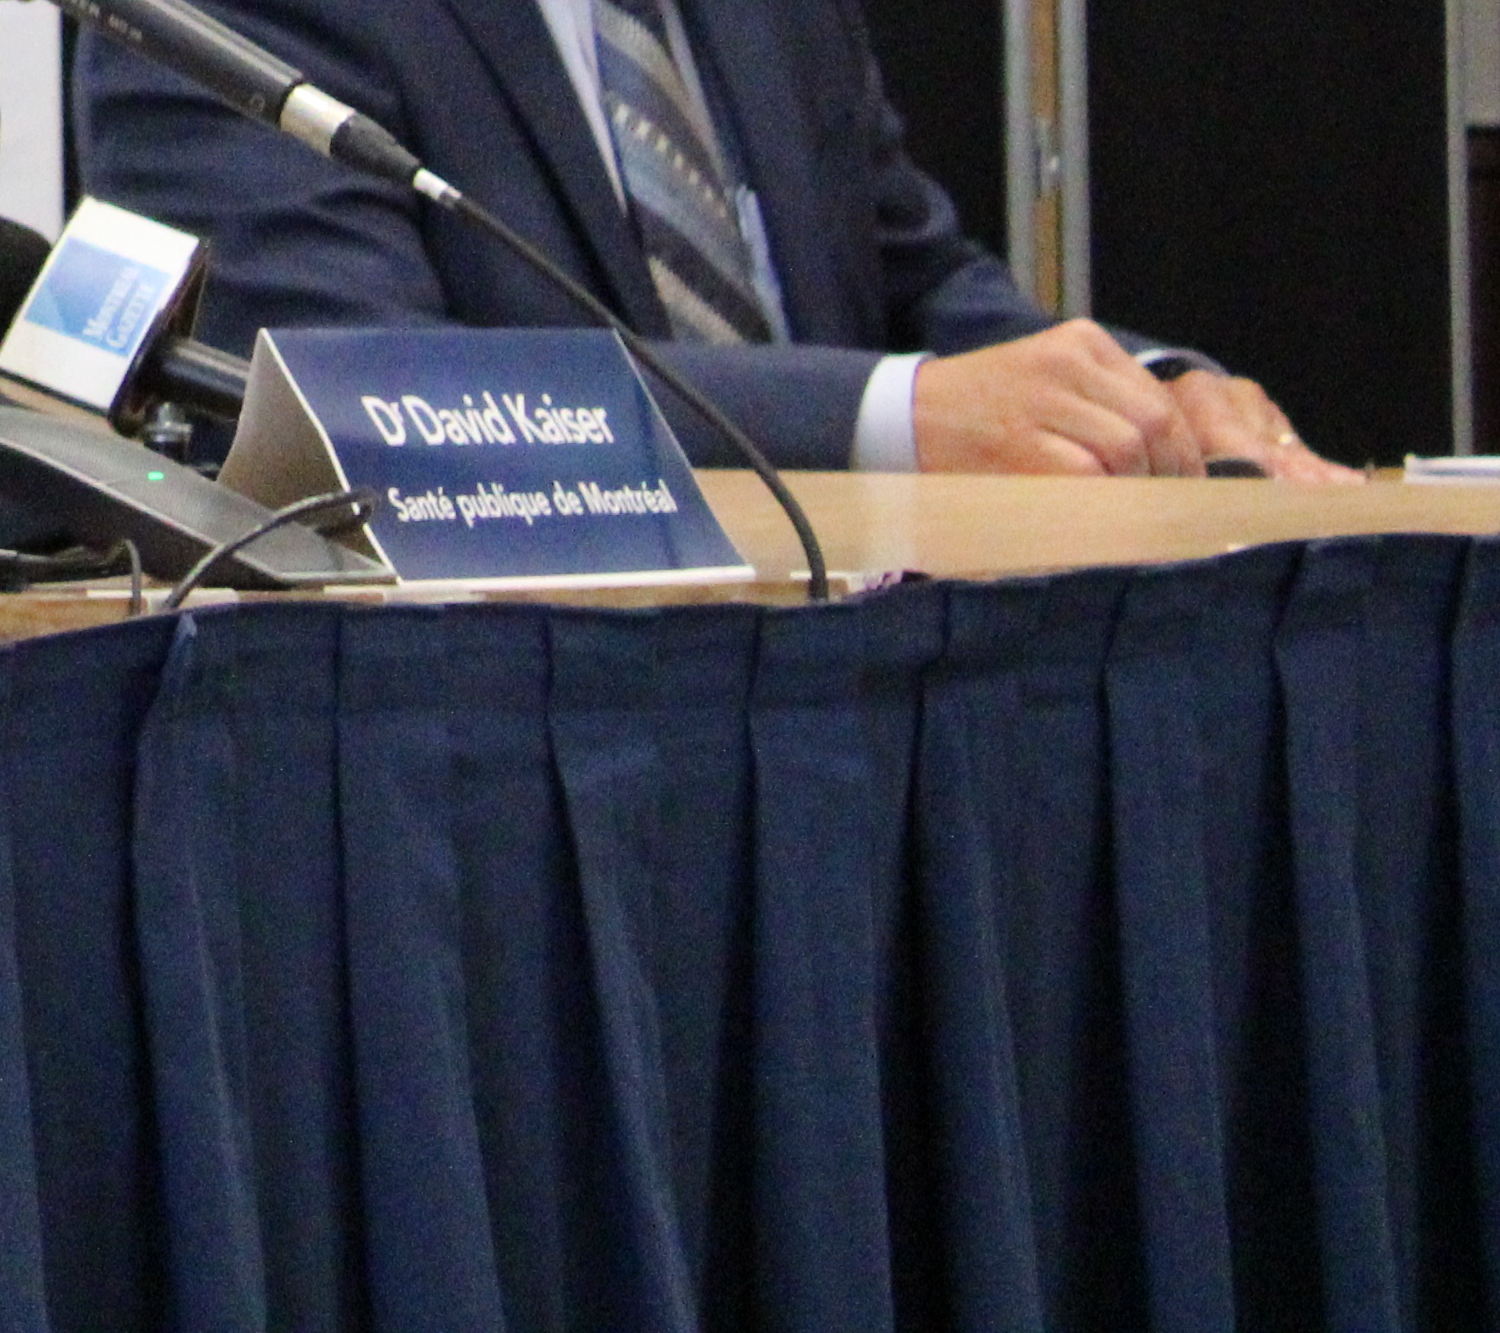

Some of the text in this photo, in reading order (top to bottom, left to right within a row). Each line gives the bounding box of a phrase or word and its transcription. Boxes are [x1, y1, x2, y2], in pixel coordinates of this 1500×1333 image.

[401, 390, 517, 446] David
[501, 392, 615, 444] Kaiser
[387, 478, 678, 528] Santé publique de Montréal
